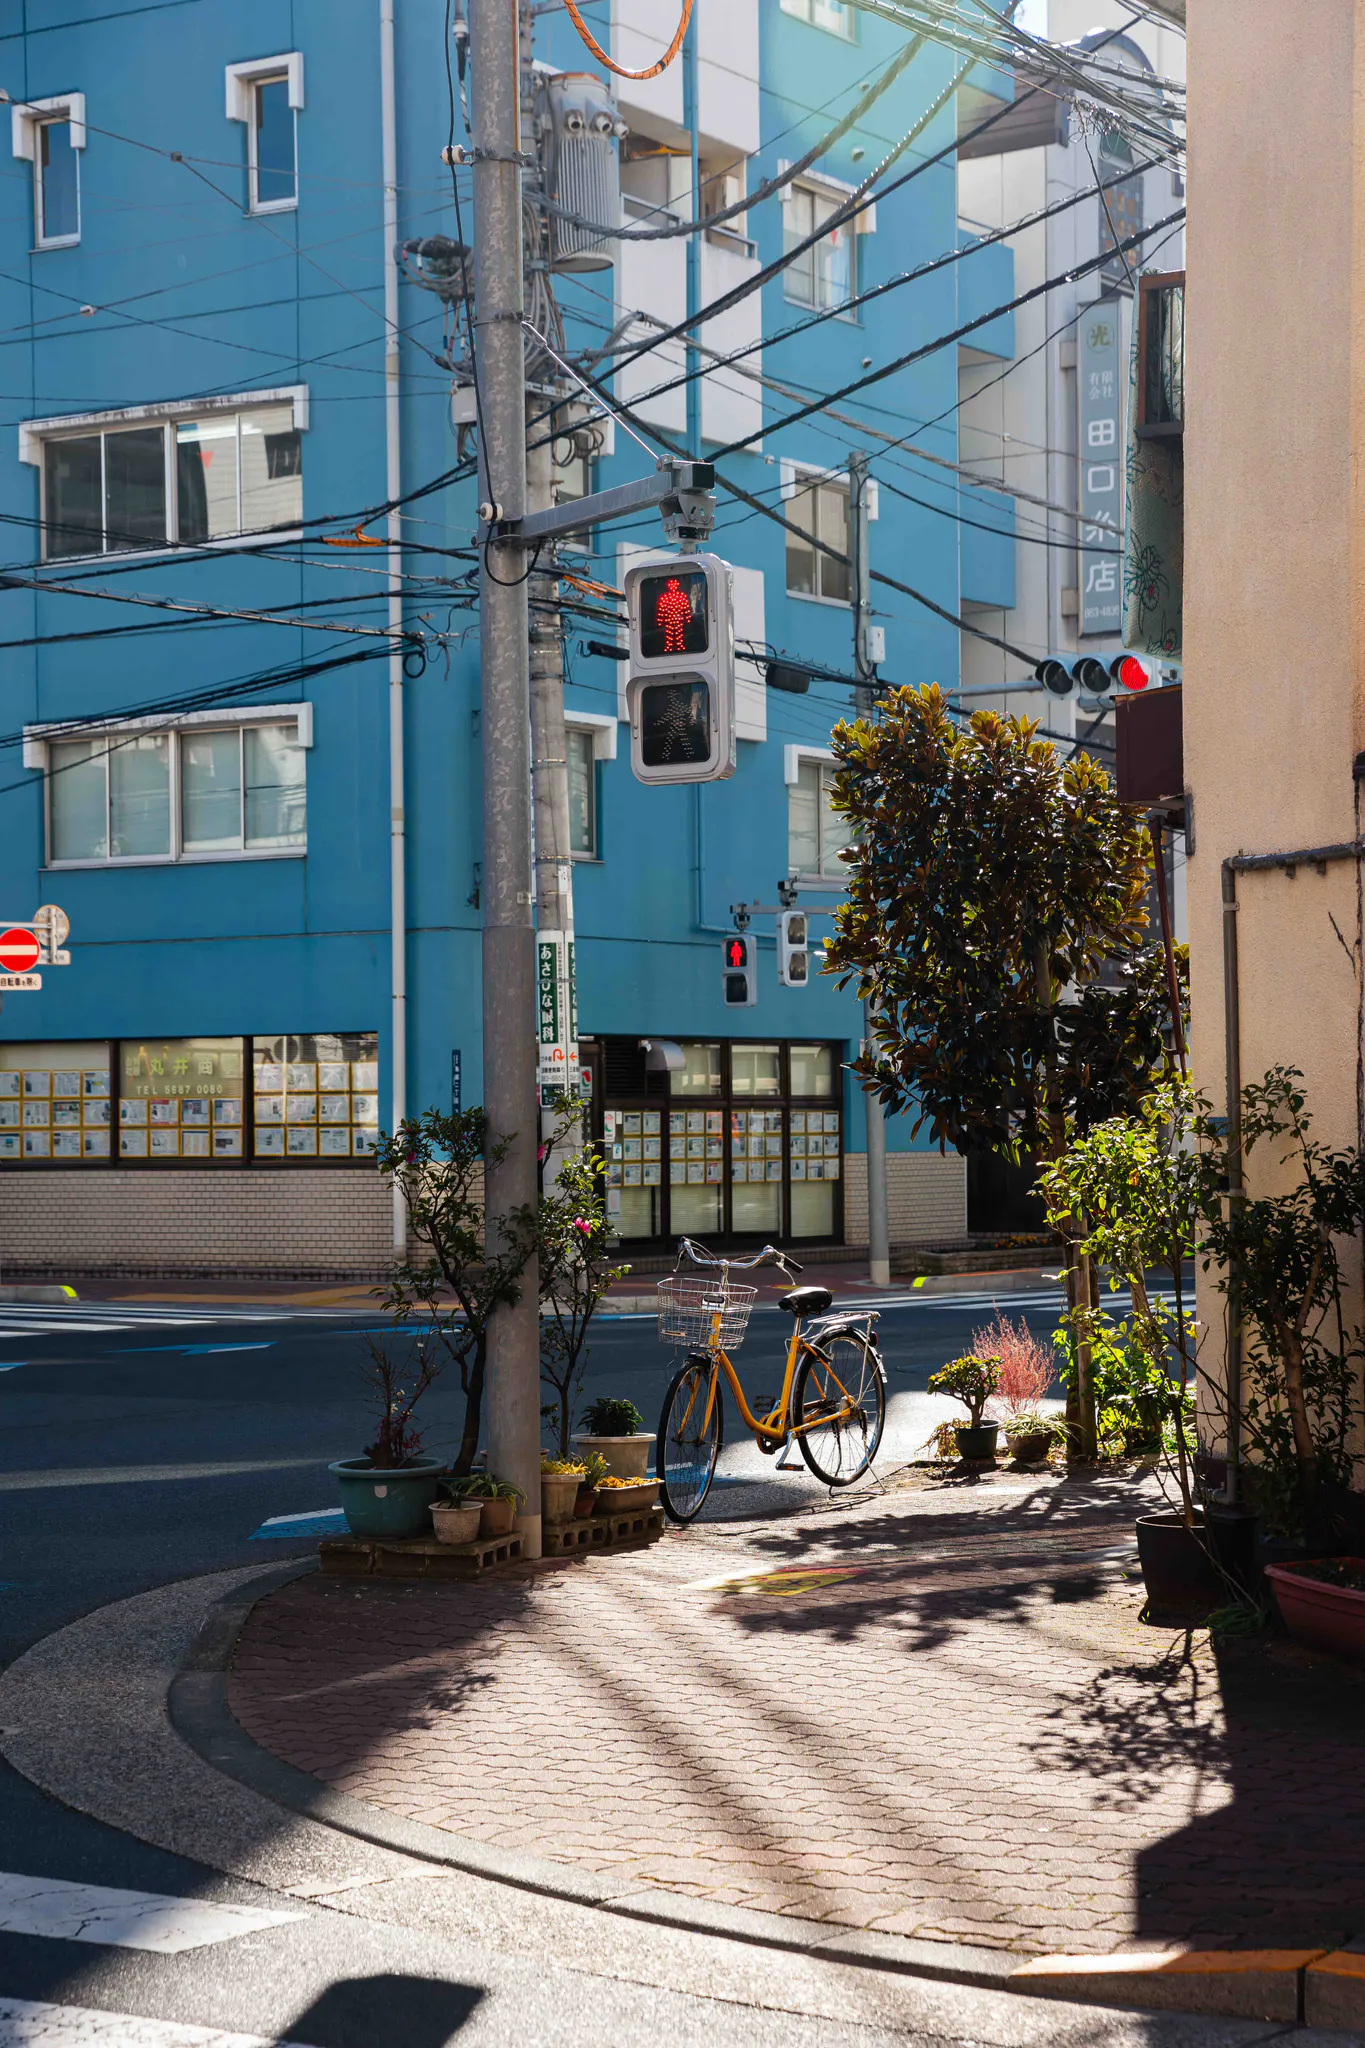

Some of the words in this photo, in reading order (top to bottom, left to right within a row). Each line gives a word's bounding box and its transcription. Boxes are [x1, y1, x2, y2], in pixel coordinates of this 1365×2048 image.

[1091, 325, 1110, 348] 光
[136, 1086, 157, 1095] TEL
[165, 1085, 191, 1094] 5687
[196, 1085, 223, 1094] 0080
